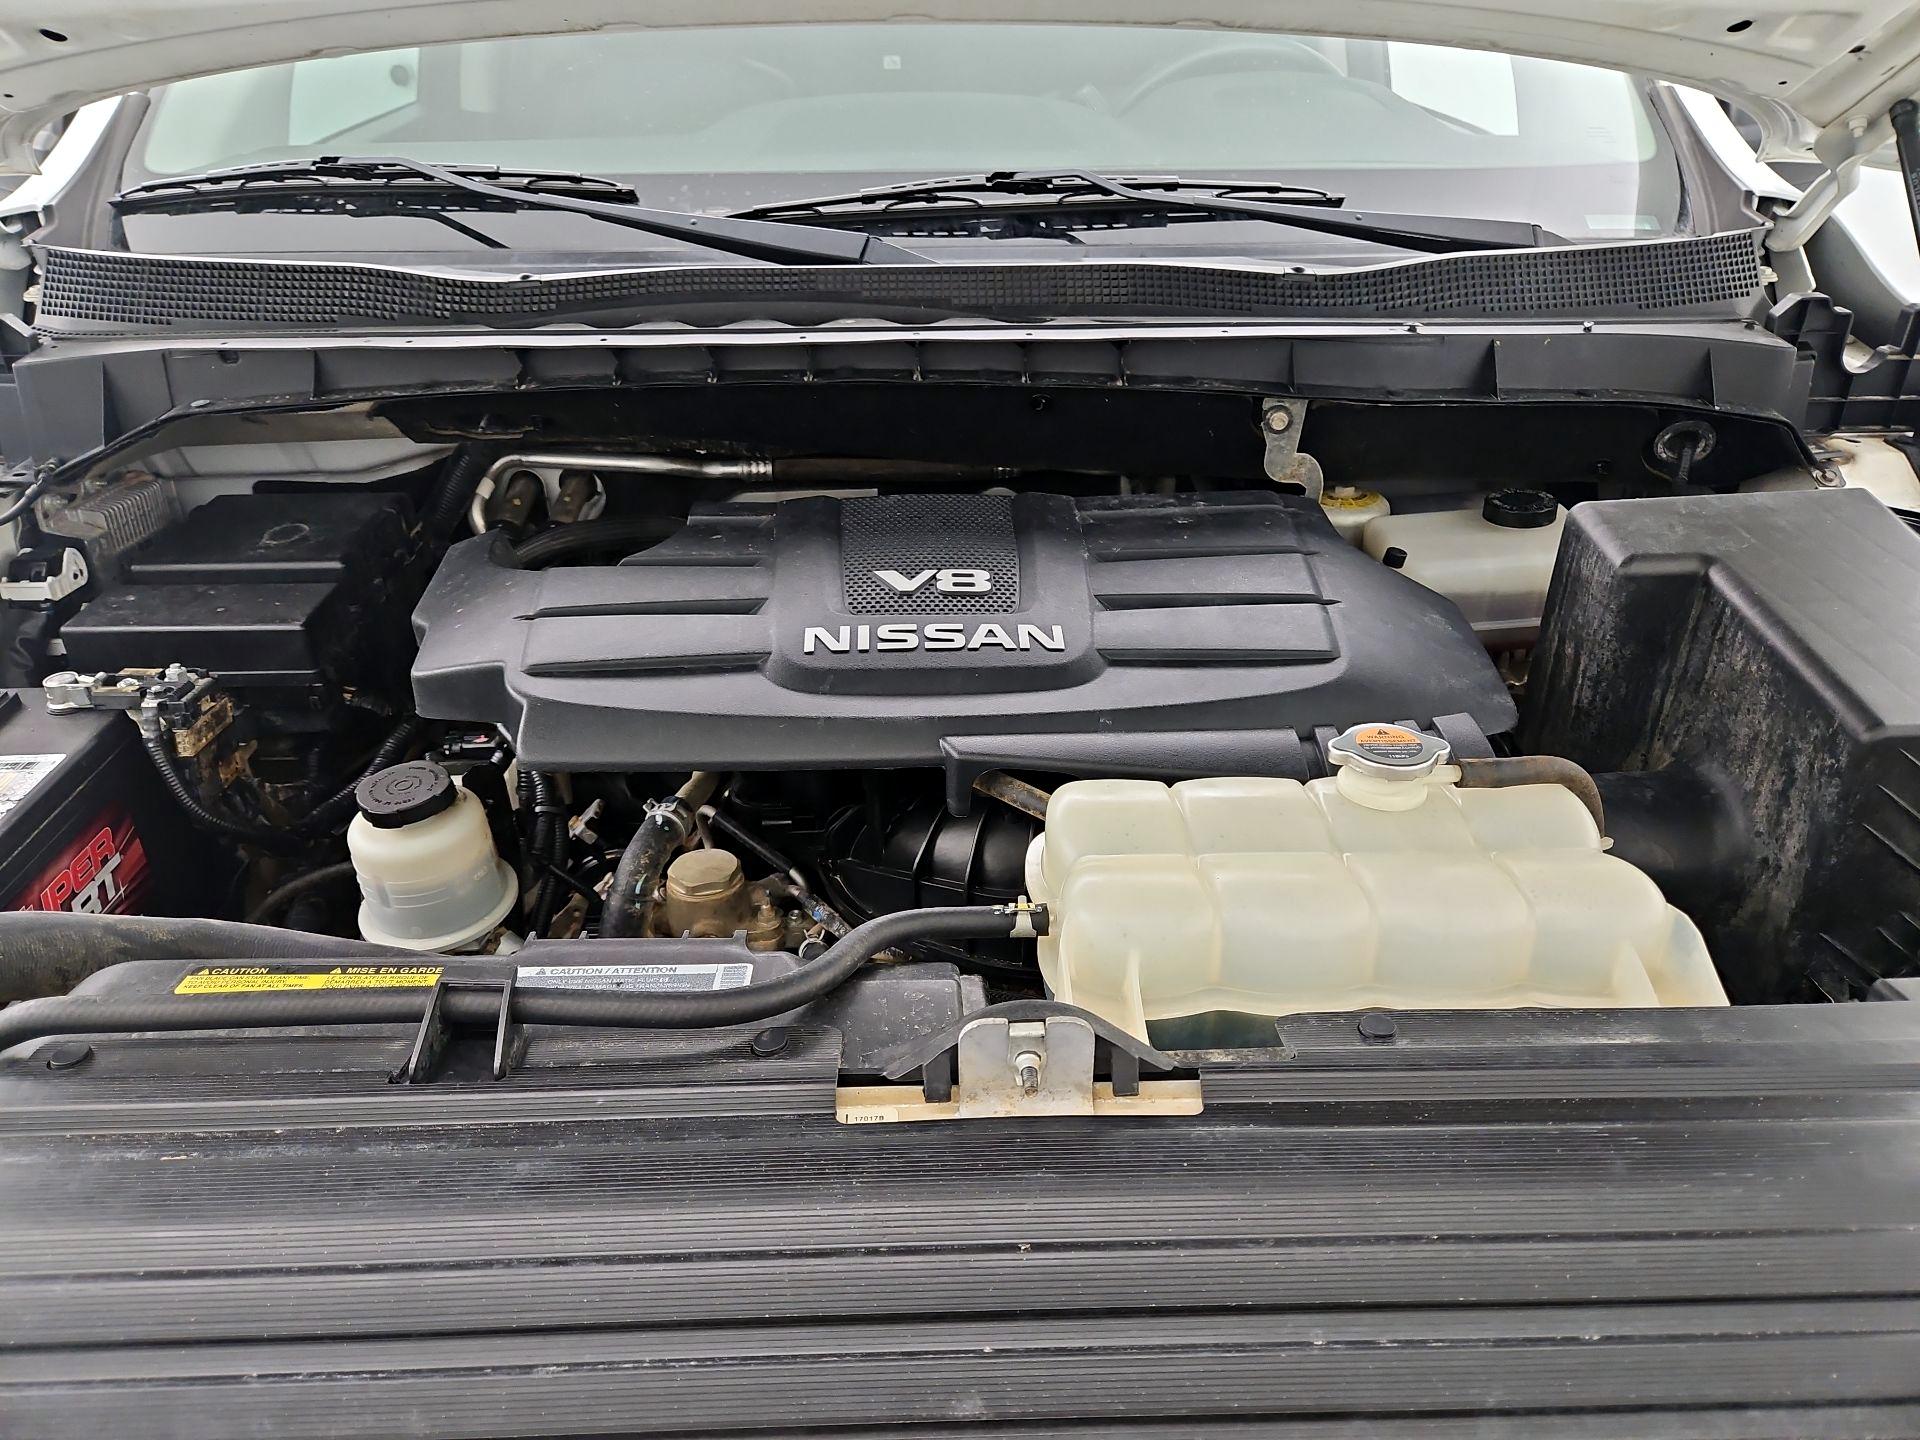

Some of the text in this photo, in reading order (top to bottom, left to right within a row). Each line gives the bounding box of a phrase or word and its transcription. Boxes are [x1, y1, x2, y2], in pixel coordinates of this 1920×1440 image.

[873, 569, 992, 596] V8
[804, 624, 1066, 654] NISSAN
[211, 967, 270, 975] CAUTION
[345, 966, 445, 974] MISE EN GARDE
[550, 967, 604, 975] CAUTION
[609, 966, 678, 975] ATTENTION
